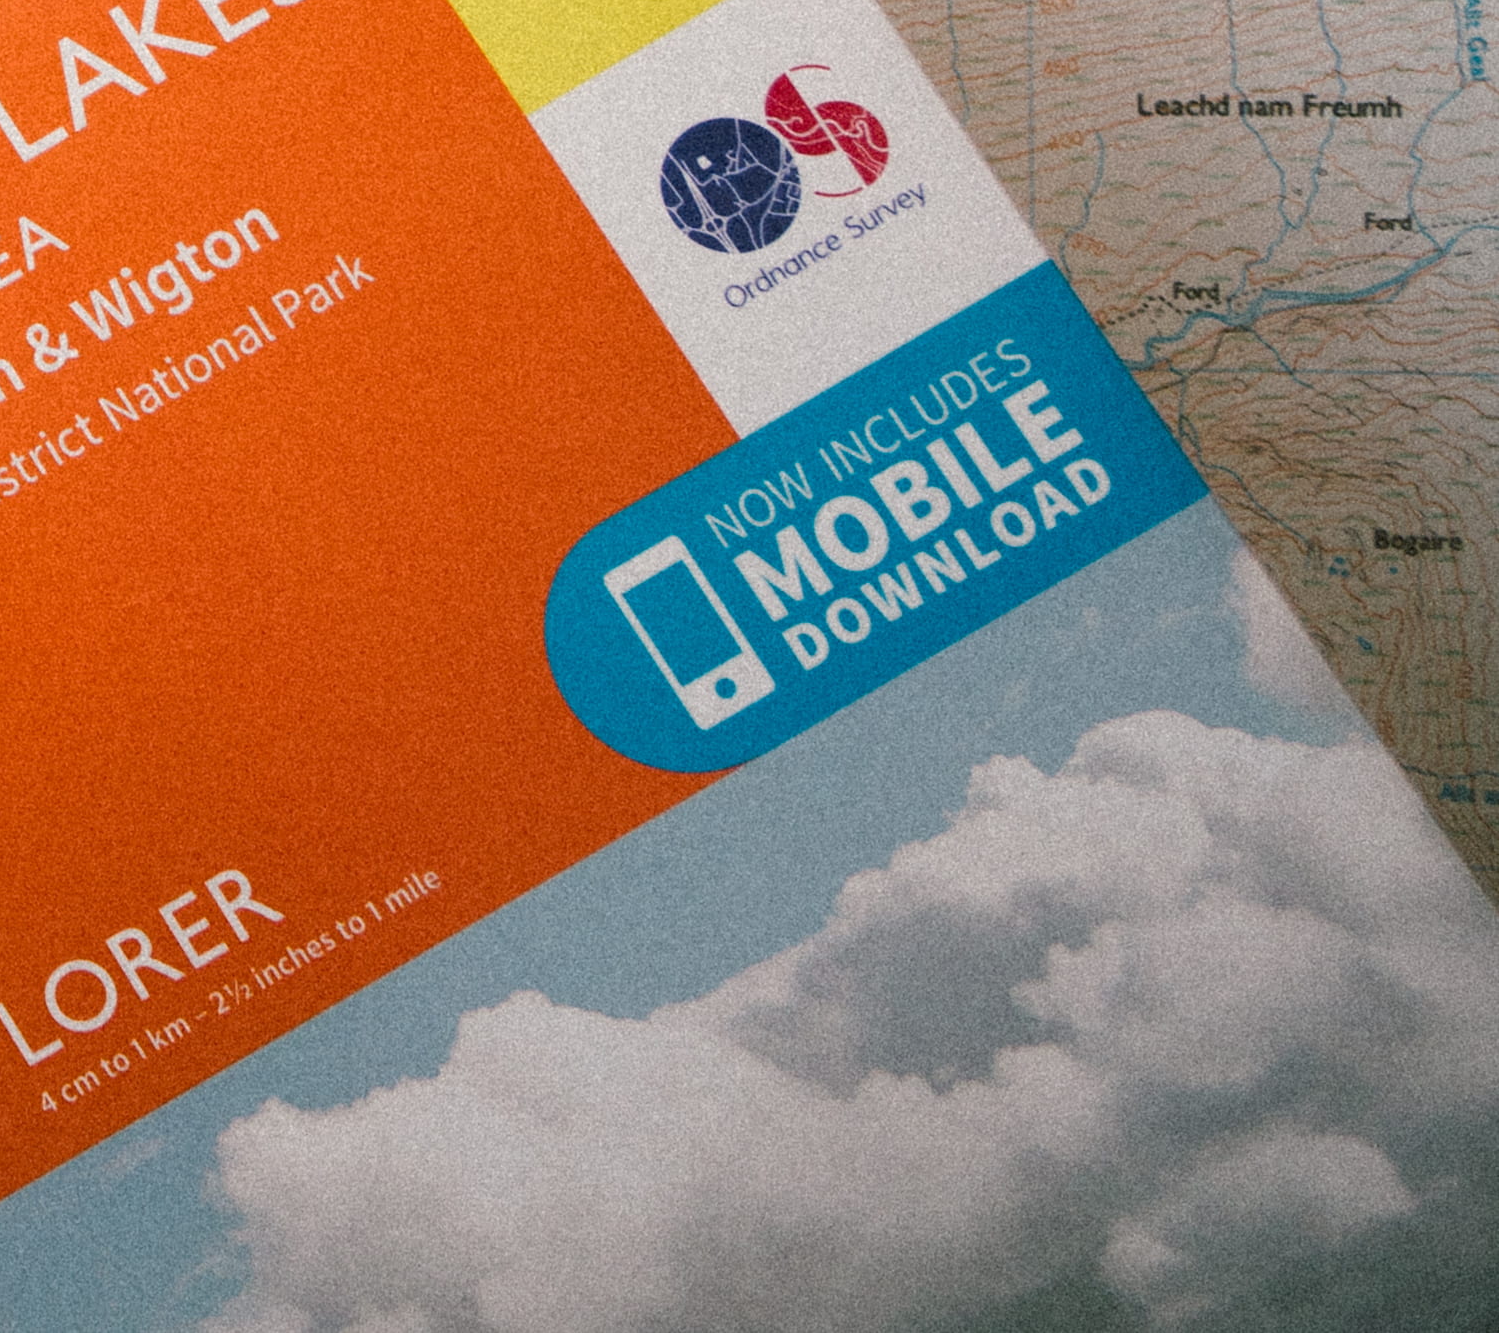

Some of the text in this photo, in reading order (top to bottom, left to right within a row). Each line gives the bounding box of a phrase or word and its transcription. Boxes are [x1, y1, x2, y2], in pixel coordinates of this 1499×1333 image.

[1136, 93, 1404, 119] Leachd nam Freumh
[25, 319, 79, 377] &
[69, 206, 280, 344] Wigton
[722, 182, 929, 312] Ordnance Survey
[103, 313, 279, 427] National
[277, 254, 377, 330] Park
[704, 338, 1035, 551] NOW INCLUDES
[732, 380, 1086, 624] MOBILE
[780, 455, 1115, 673] DOWNLOAD
